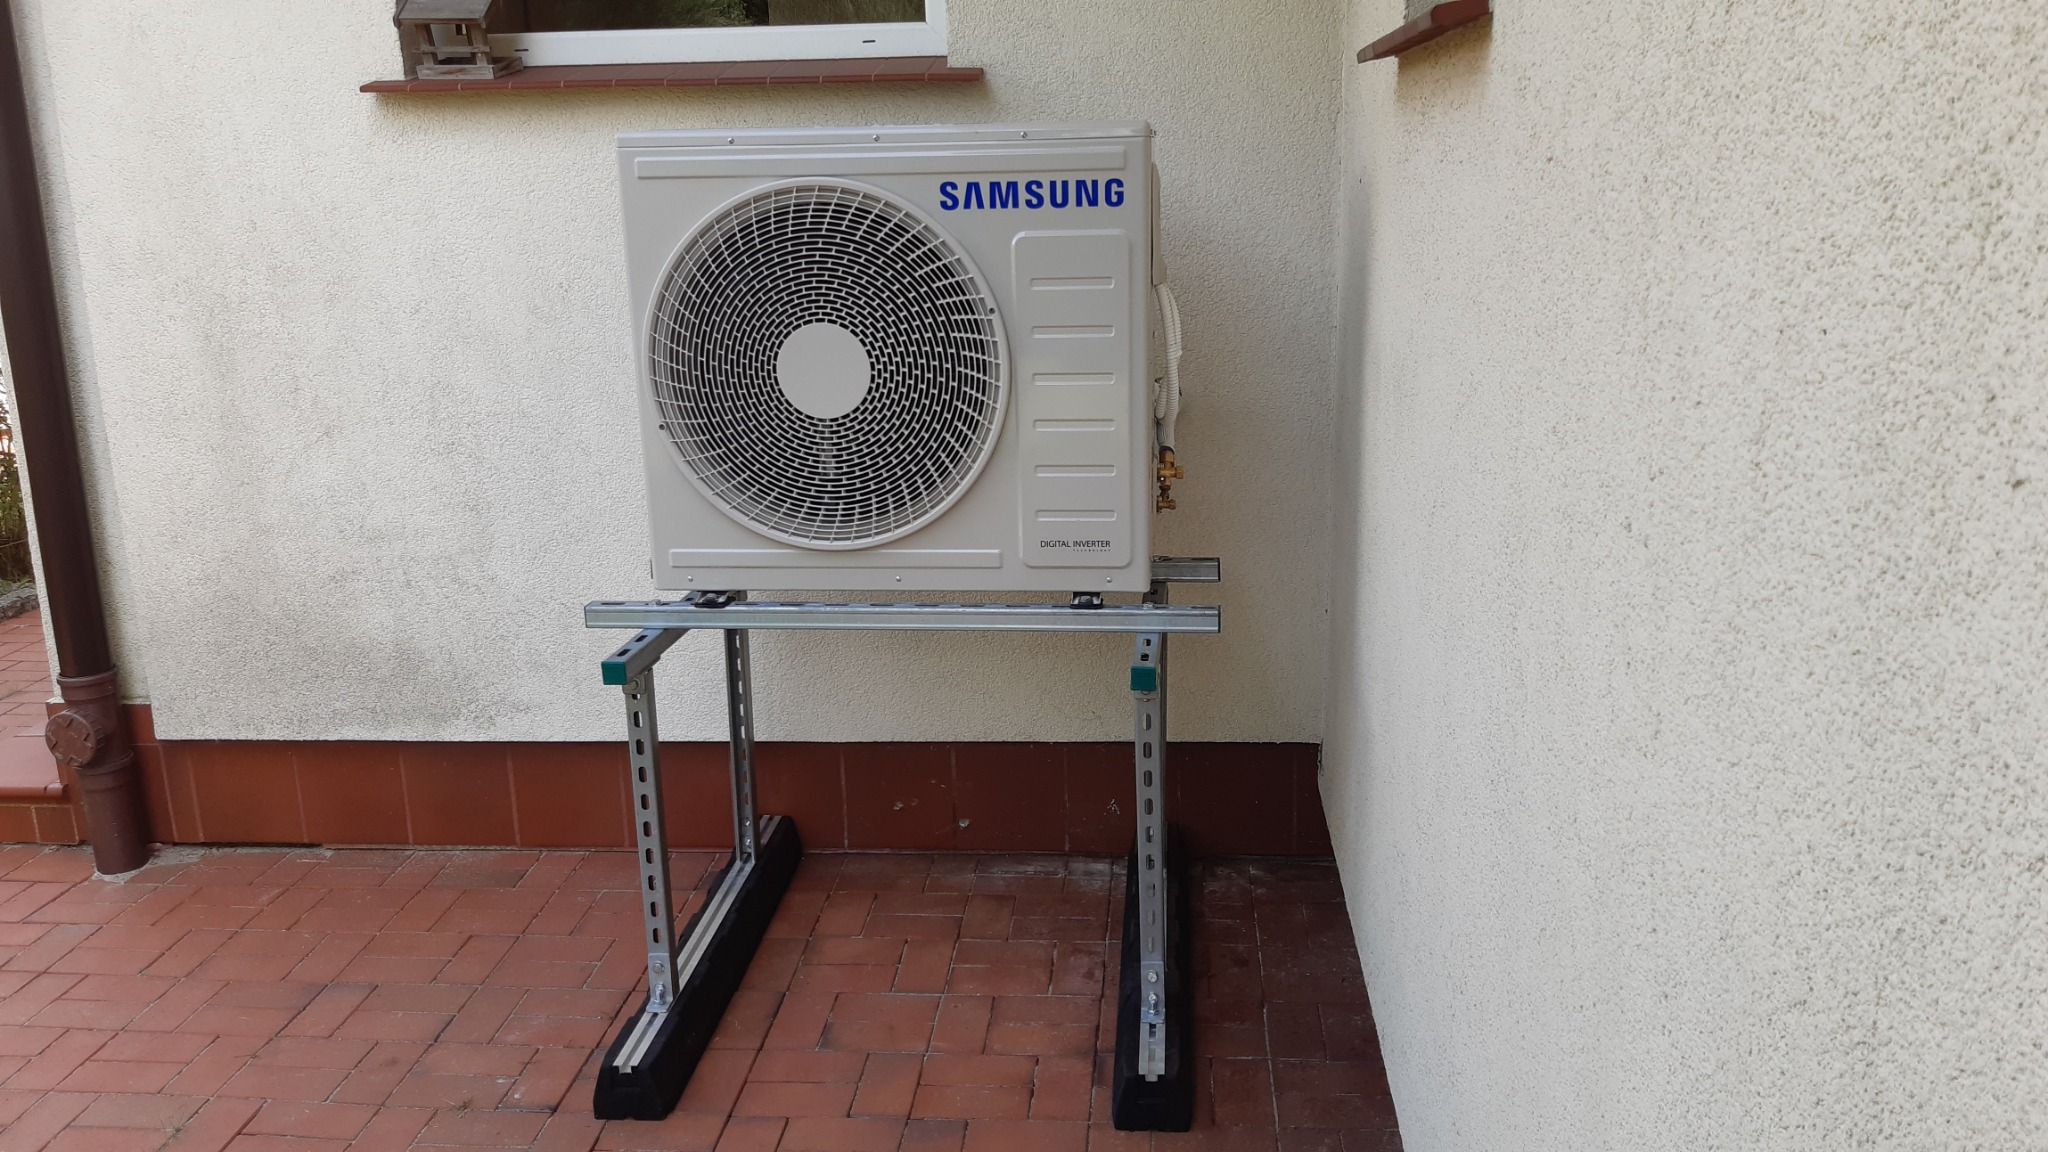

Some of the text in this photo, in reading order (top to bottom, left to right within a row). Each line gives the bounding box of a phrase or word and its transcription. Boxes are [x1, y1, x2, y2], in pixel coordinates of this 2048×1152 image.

[939, 178, 1125, 211] SAMSUNG
[1040, 540, 1111, 548] DIGITAL INVERTER
